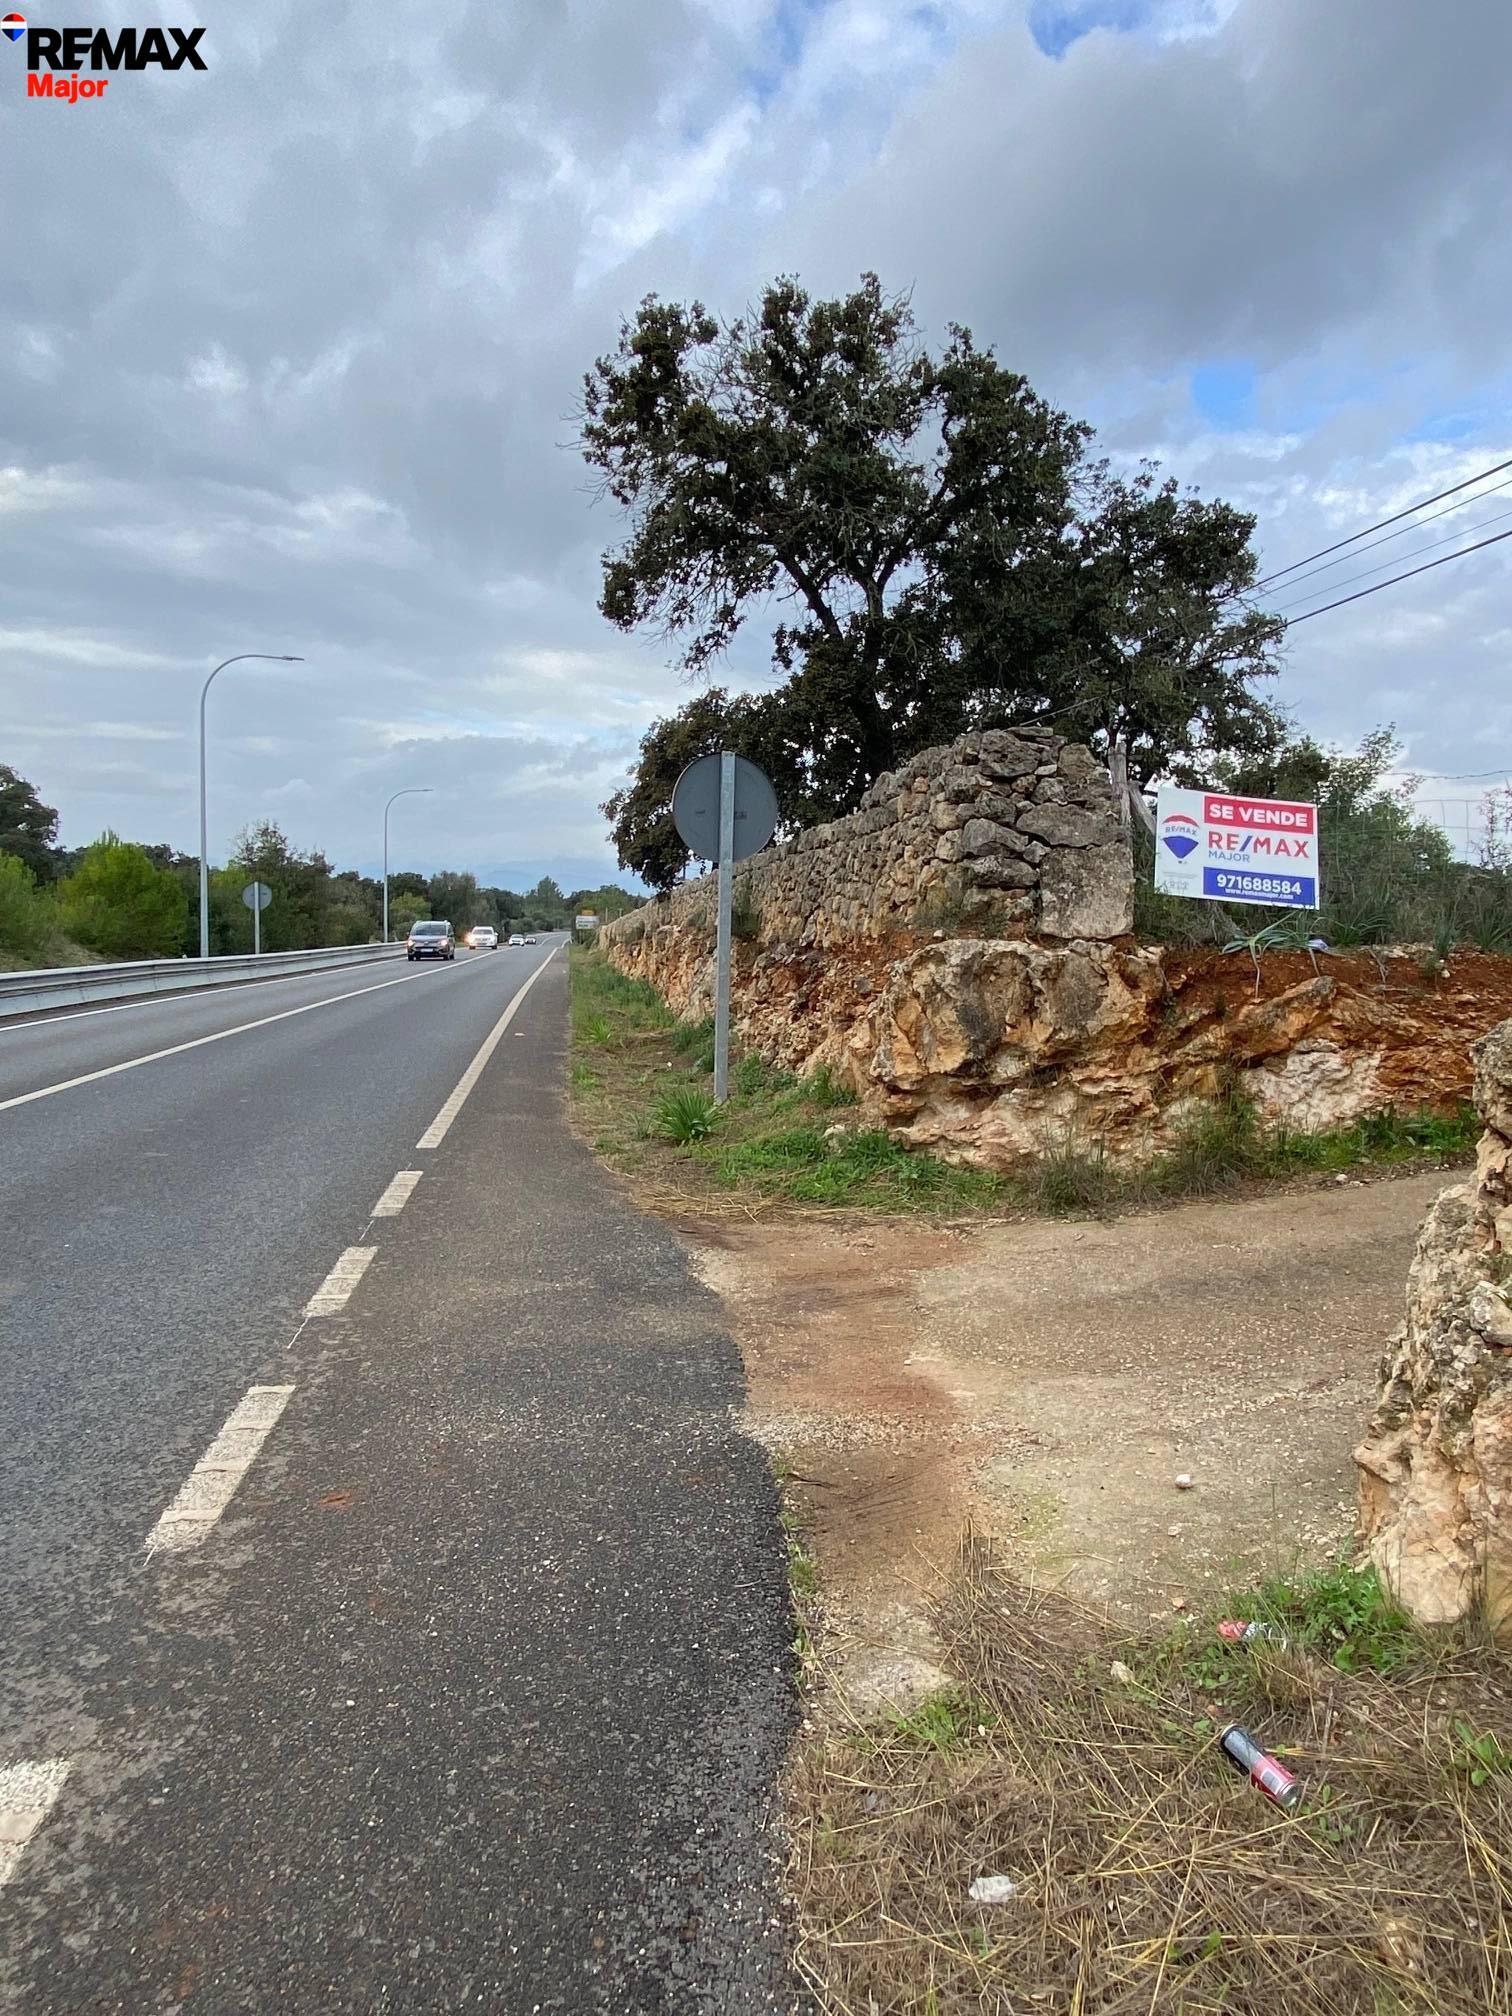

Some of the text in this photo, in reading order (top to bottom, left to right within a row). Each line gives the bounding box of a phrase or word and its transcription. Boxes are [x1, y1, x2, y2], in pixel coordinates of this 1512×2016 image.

[1209, 804, 1308, 827] SE VENDE
[1208, 831, 1309, 858] RE/MAX
[1208, 850, 1251, 863] MAJOR
[1217, 874, 1302, 895] 971688584
